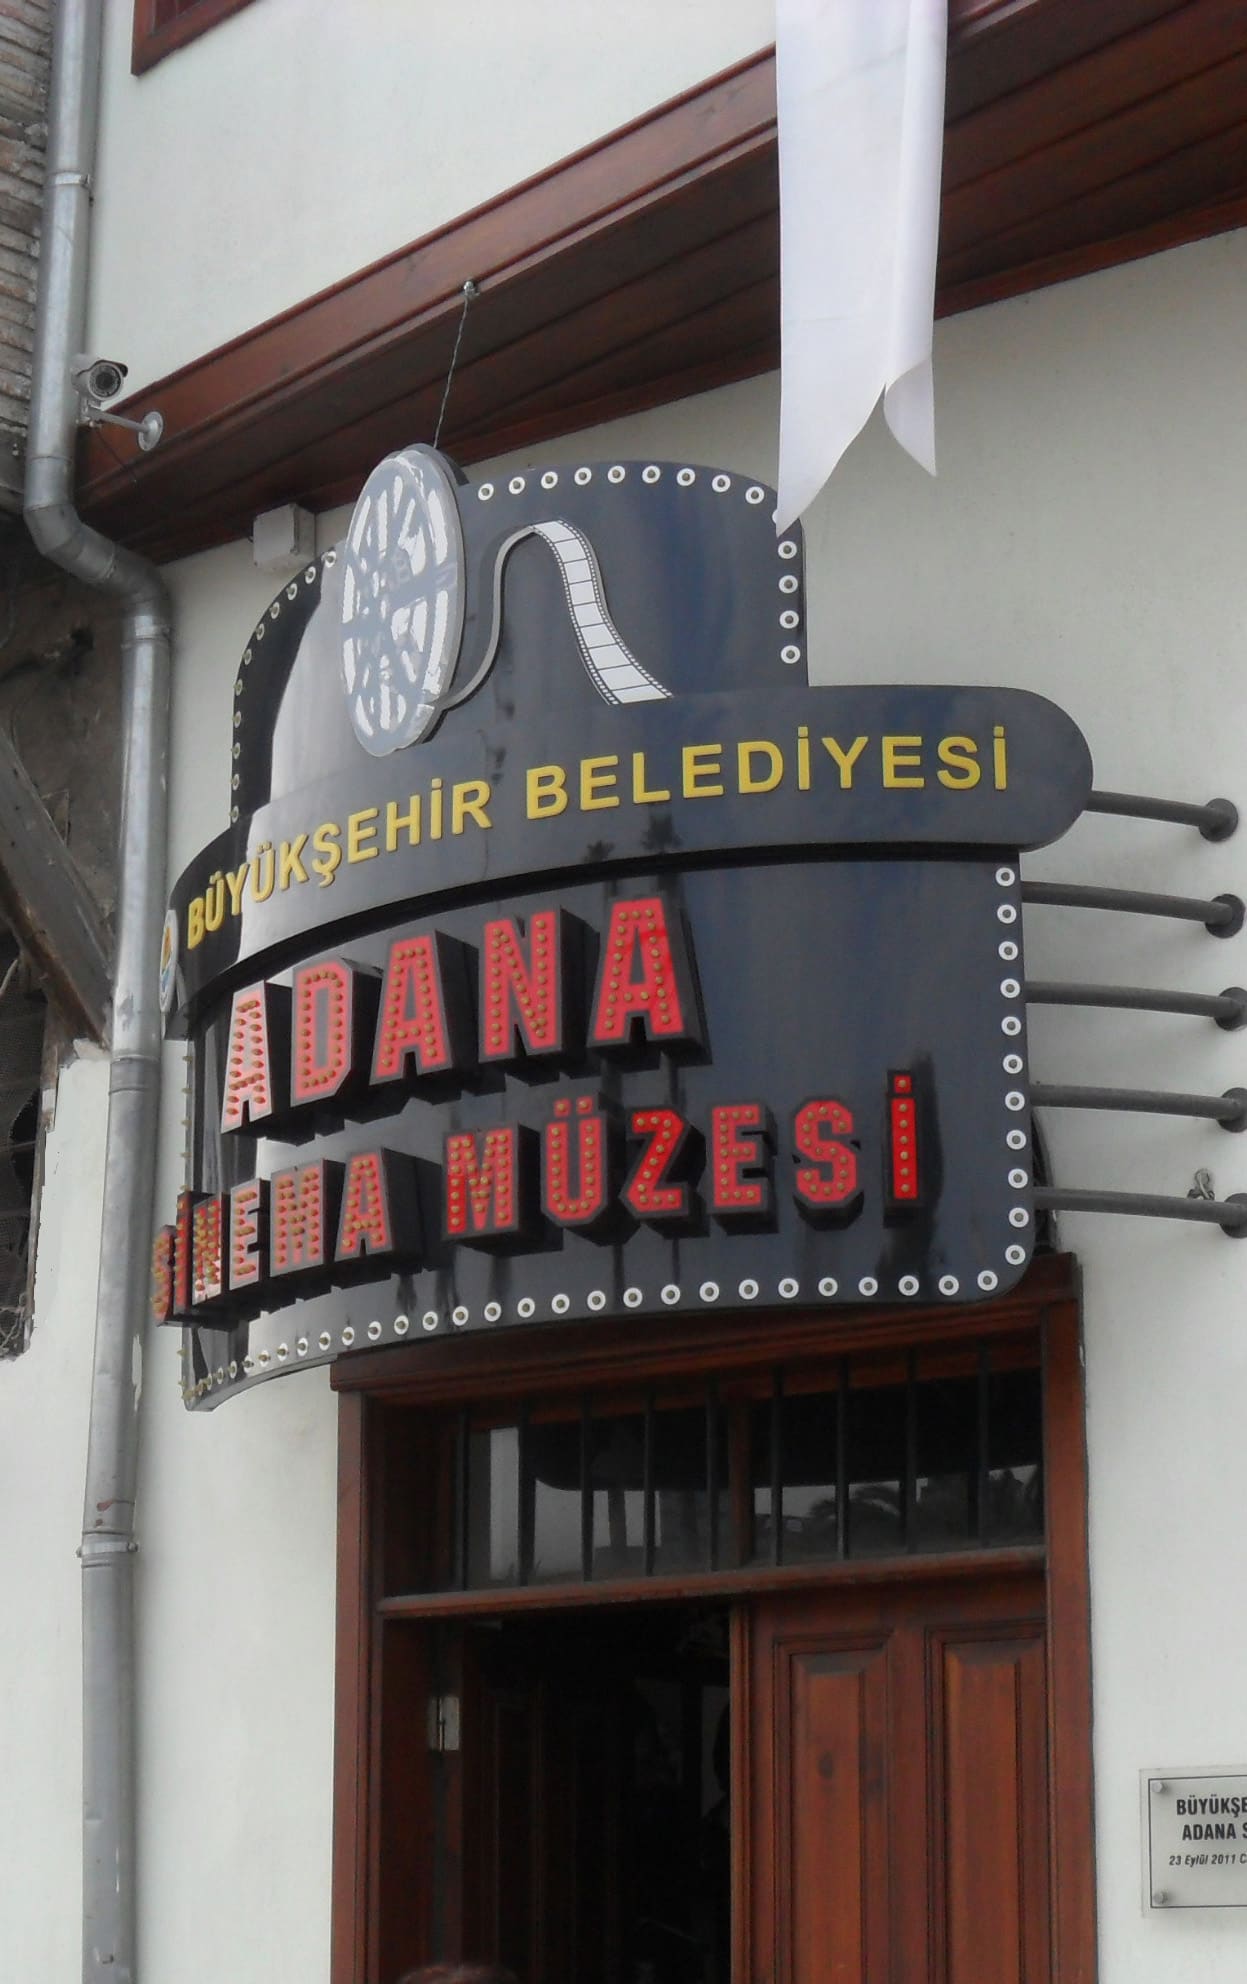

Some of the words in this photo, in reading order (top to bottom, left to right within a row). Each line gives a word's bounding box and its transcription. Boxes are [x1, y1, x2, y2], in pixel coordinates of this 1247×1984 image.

[186, 777, 493, 950] BÜYÜKŞEHİR
[526, 726, 1007, 820] BELEDİYESİ
[221, 897, 687, 1133] ADANA
[444, 1070, 918, 1240] MÜZESİ
[1169, 1855, 1182, 1866] 23
[1185, 1855, 1208, 1867] Eylül
[1211, 1854, 1236, 1865] 2011
[1182, 1823, 1237, 1841] ADANA
